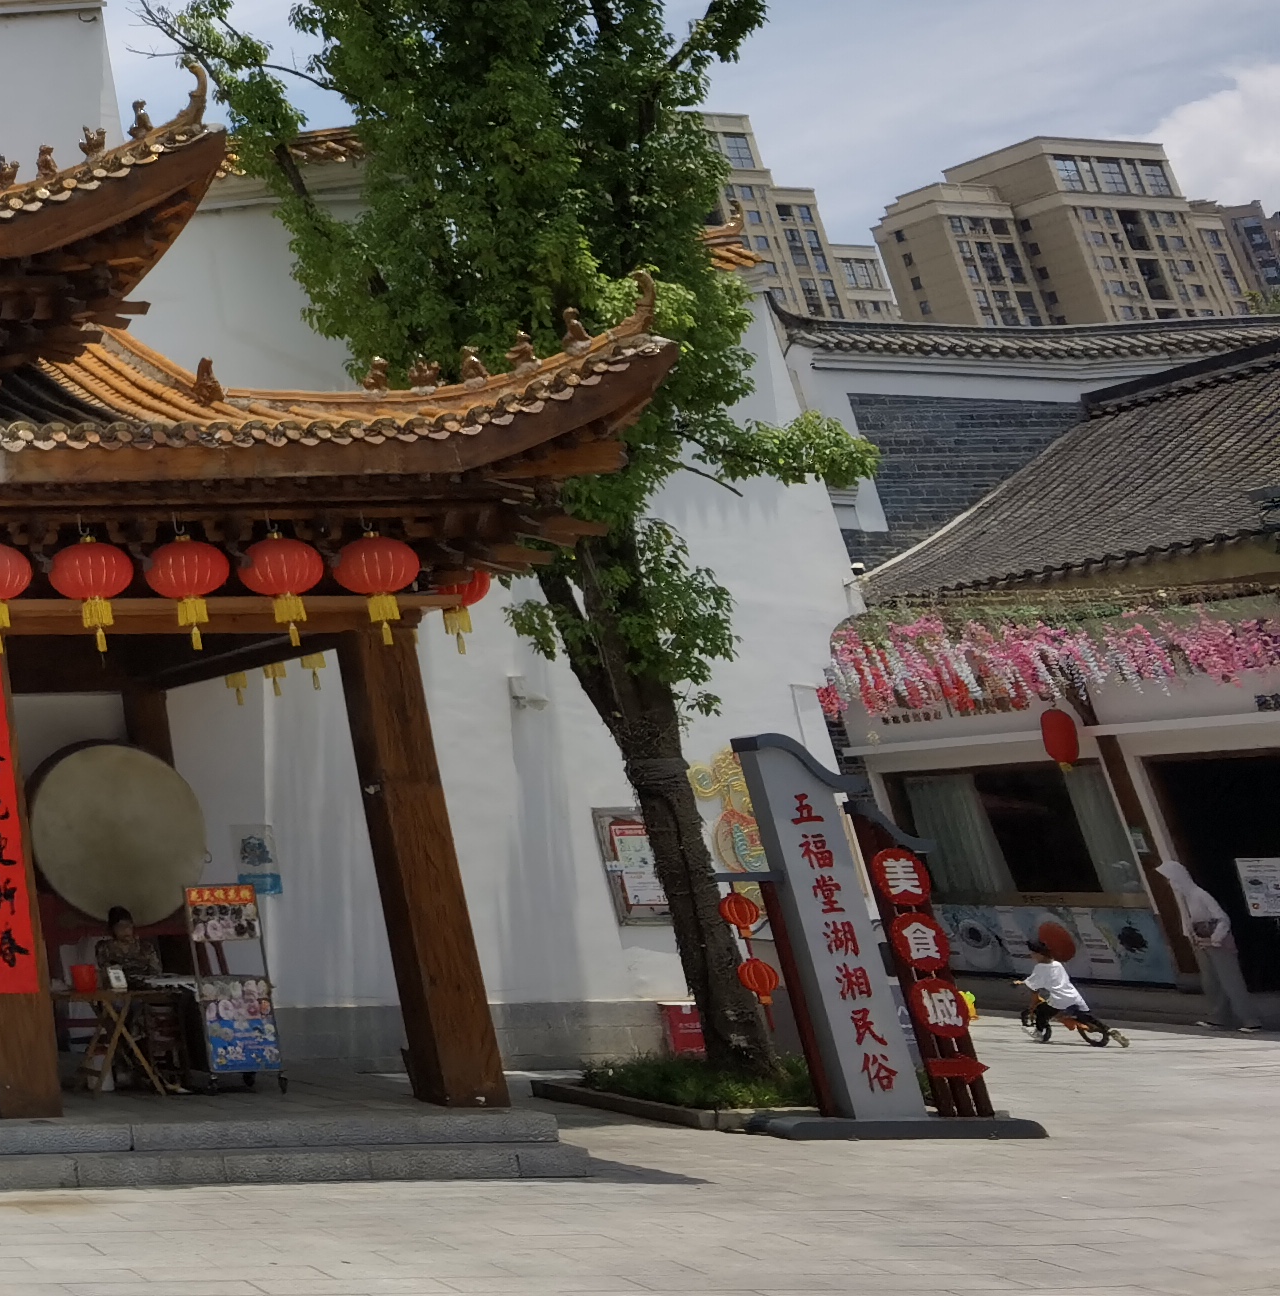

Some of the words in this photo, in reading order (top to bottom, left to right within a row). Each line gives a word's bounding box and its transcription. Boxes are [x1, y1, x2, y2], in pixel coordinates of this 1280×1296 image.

[791, 793, 898, 1093] 五福堂湖湘民俗
[882, 857, 964, 1029] 美食城
